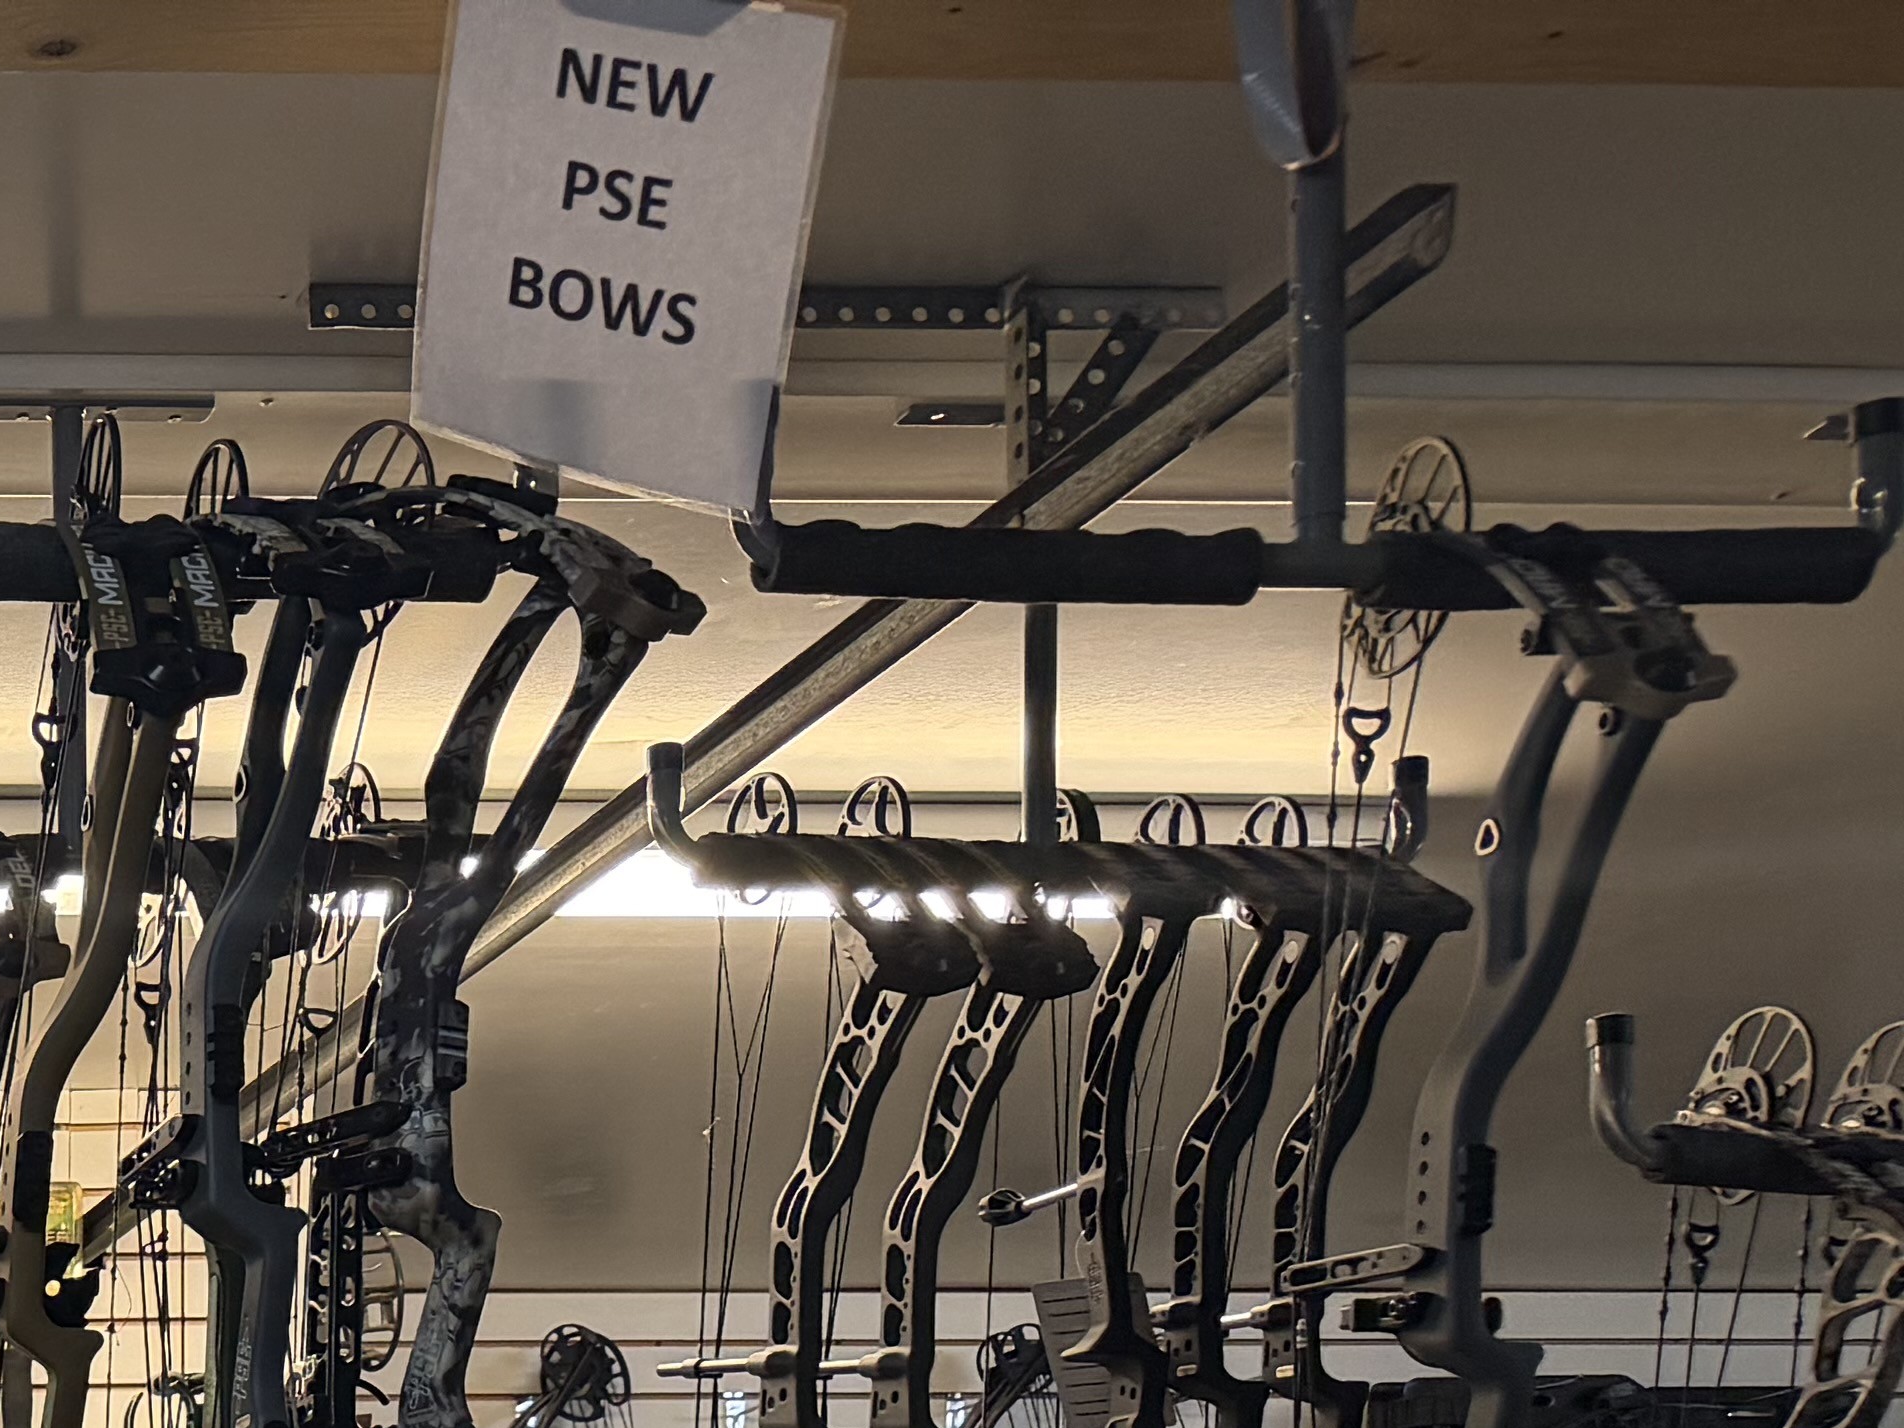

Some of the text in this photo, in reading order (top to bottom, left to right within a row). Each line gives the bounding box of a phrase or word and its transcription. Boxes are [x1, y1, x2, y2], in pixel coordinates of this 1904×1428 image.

[556, 48, 715, 123] NEW
[562, 160, 673, 230] PSE
[508, 257, 698, 345] BOWS
